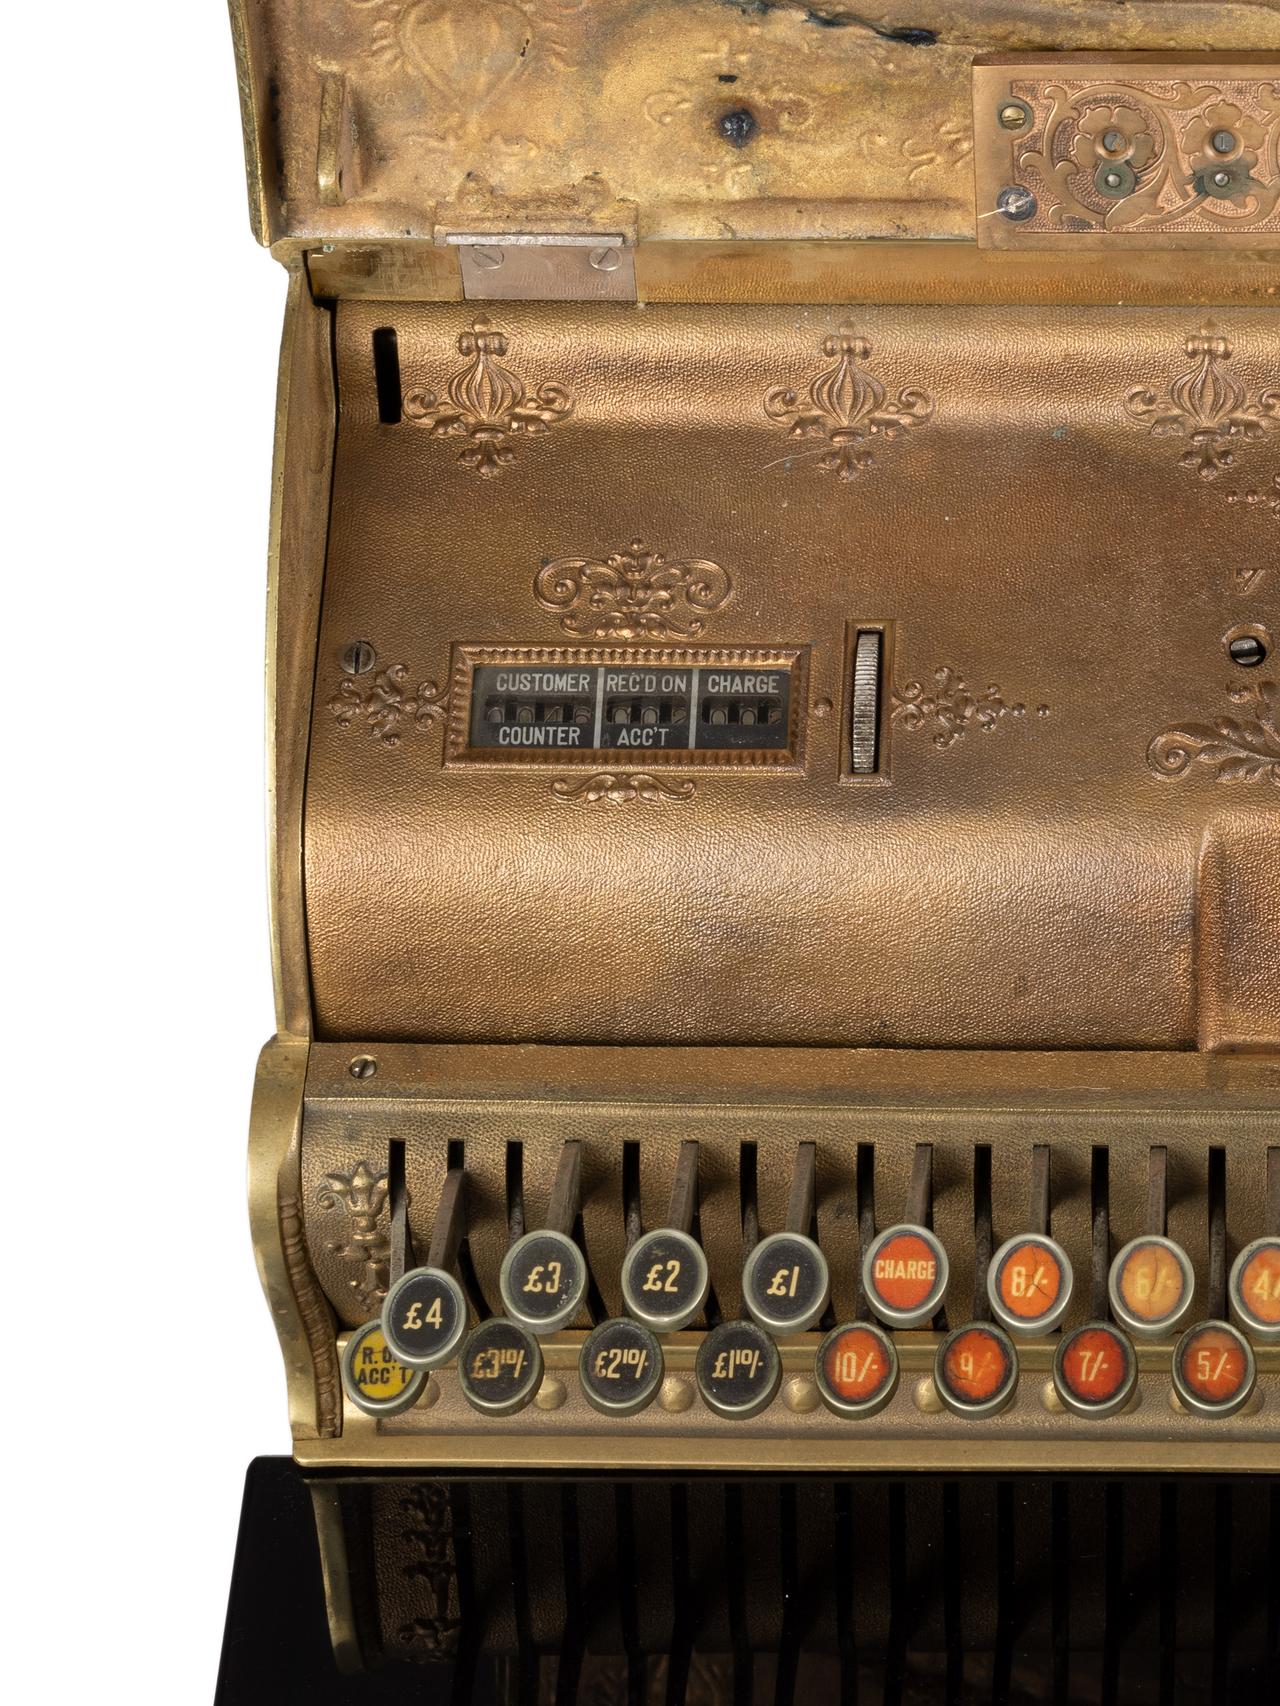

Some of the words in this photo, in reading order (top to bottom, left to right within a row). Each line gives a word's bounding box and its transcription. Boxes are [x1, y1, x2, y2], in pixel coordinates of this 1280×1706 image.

[496, 673, 590, 692] CUSTOMER
[606, 672, 656, 692] REC'D
[662, 674, 687, 692] ON
[708, 675, 779, 694] CHARGE
[499, 726, 580, 746] COUNTER
[617, 727, 669, 746] ACC'T
[523, 1261, 562, 1293] £3
[642, 1260, 680, 1292] £2
[875, 1259, 935, 1280] CHARGE
[766, 1266, 800, 1297] £1
[402, 1297, 443, 1330] £4
[358, 1366, 409, 1385] ACC'T
